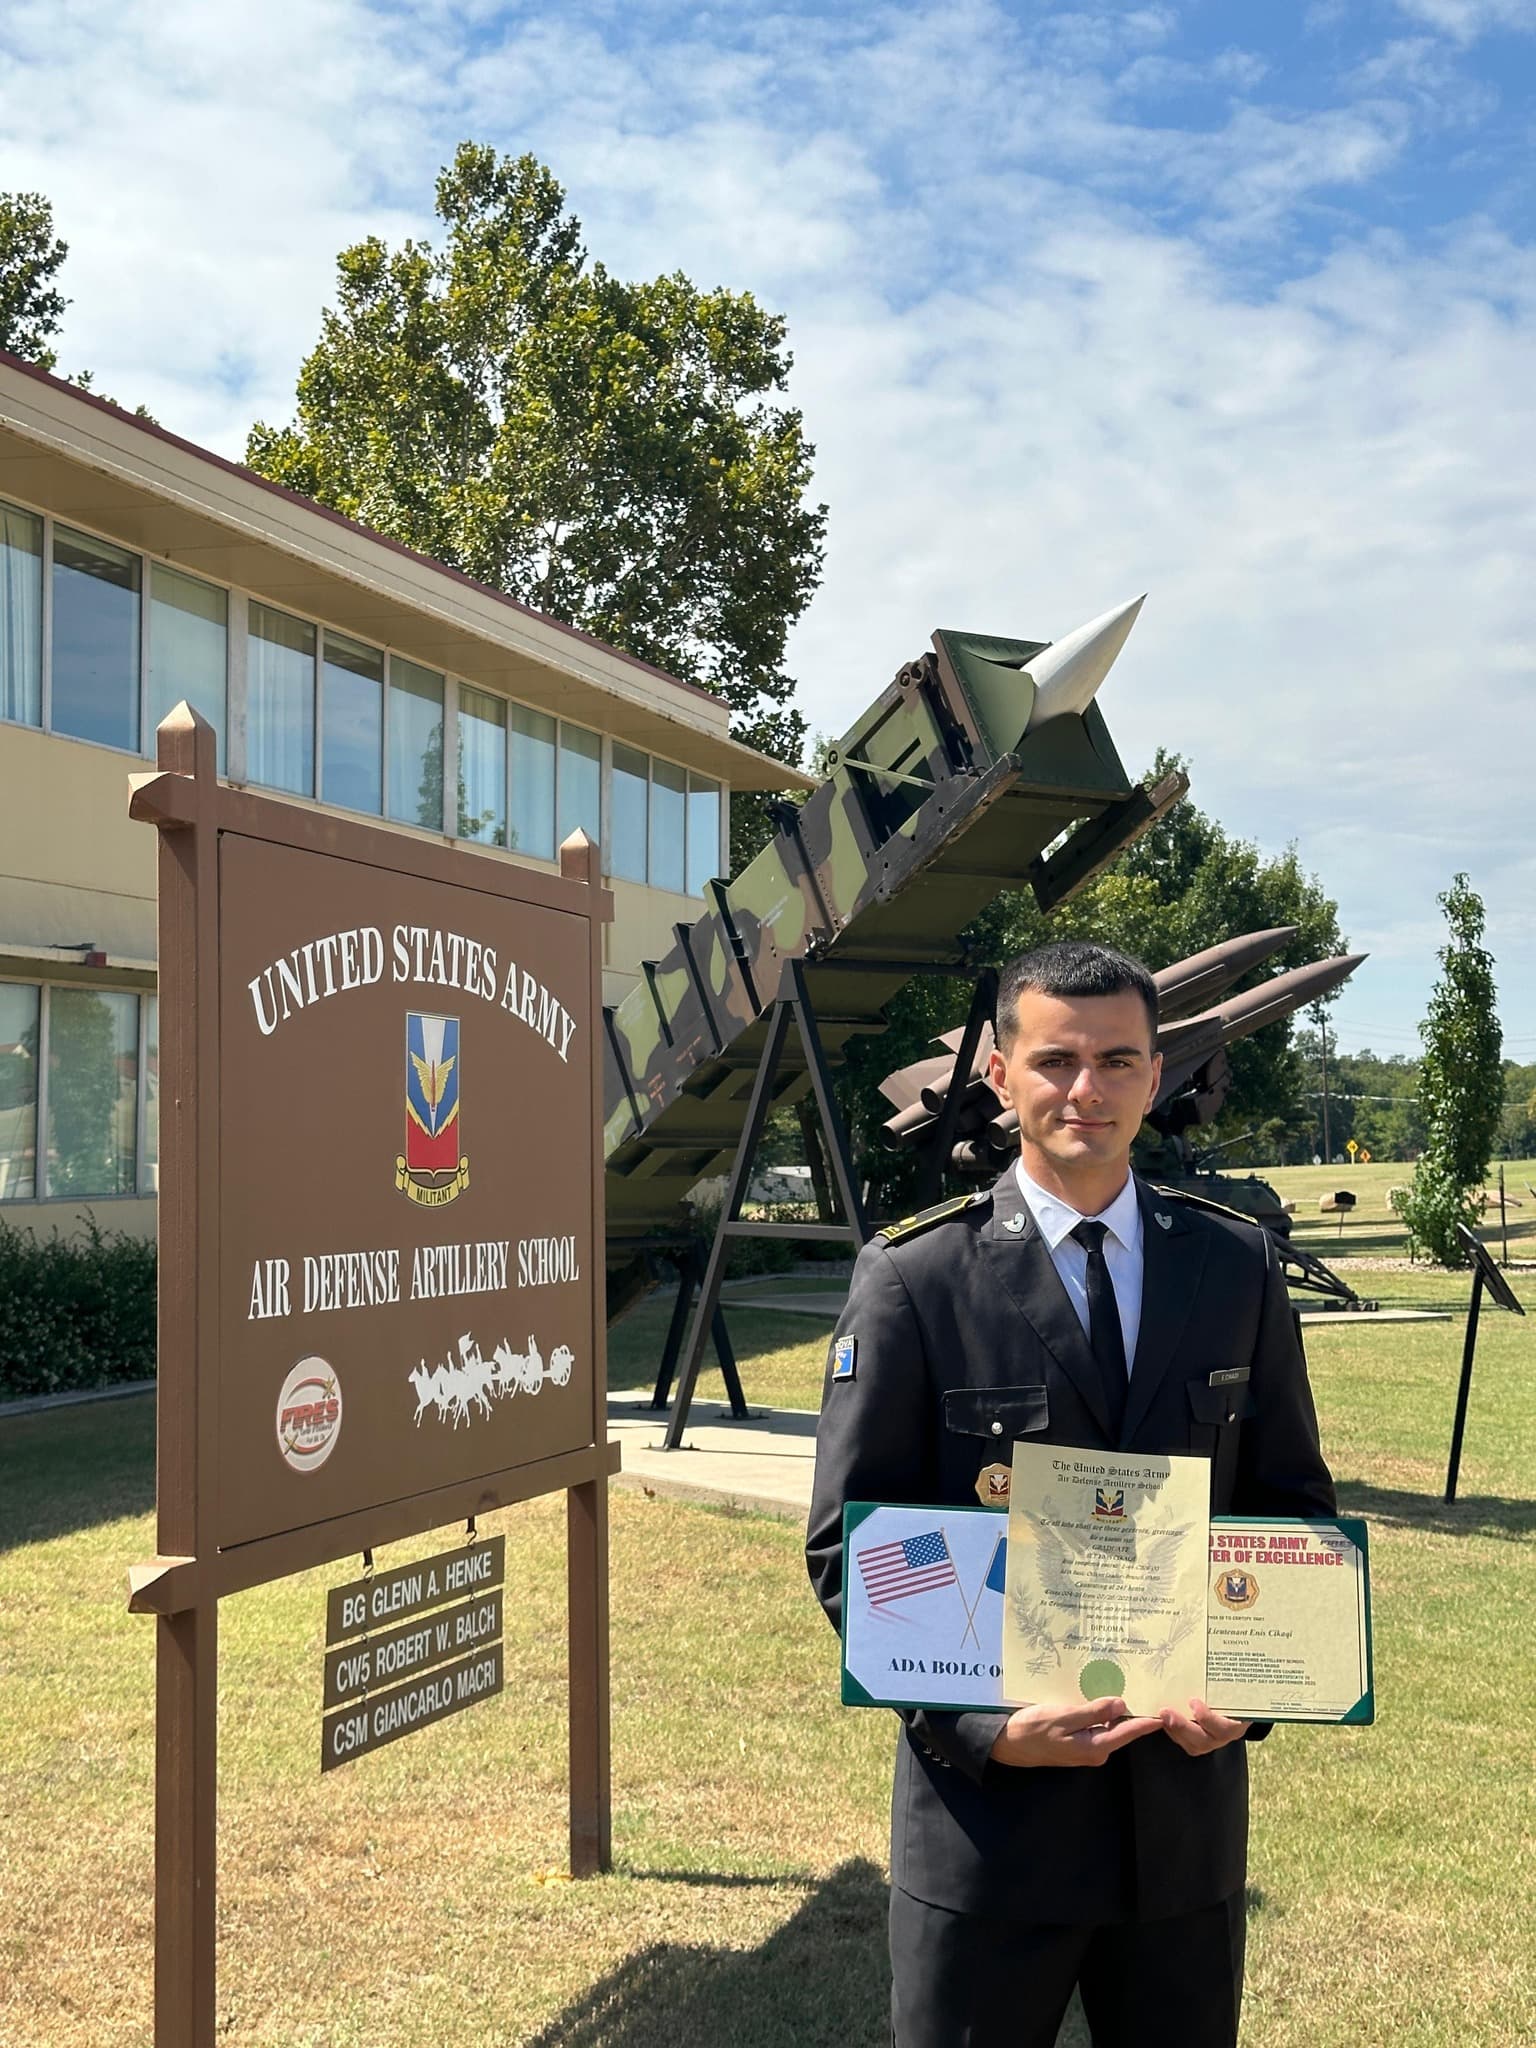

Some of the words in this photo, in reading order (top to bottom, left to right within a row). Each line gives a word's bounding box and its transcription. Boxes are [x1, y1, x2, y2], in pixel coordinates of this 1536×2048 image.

[248, 926, 384, 1036] UNITED
[392, 925, 498, 1001] STATES
[500, 961, 577, 1063] ARMY
[415, 1186, 452, 1206] MILITANT
[248, 1259, 292, 1320] AIR
[303, 1250, 400, 1313] DEFENSE
[410, 1241, 510, 1300] ARTILLERY
[518, 1236, 580, 1288] SCHOOL
[280, 1399, 339, 1435] FIRES
[1052, 1460, 1071, 1471] The
[1073, 1462, 1105, 1475] United
[1108, 1466, 1140, 1478] States
[1143, 1468, 1170, 1480] Army
[1057, 1474, 1069, 1482] Air
[1072, 1476, 1102, 1485] Defense
[1103, 1478, 1136, 1489] Artillery
[1138, 1482, 1164, 1490] School
[1217, 1535, 1266, 1548] STATES
[1268, 1536, 1309, 1550] ARMY
[1234, 1551, 1253, 1563] OF
[1255, 1551, 1344, 1566] EXCELLENCE
[342, 1594, 366, 1628] BG
[372, 1574, 422, 1618] GLENN
[427, 1571, 440, 1599] A.
[446, 1551, 492, 1591] HENKE
[1091, 1624, 1125, 1633] DIPLOMA
[1208, 1627, 1248, 1636] Lieutenant
[1249, 1628, 1266, 1637] Enis
[1268, 1629, 1293, 1639] Cikaqi
[336, 1652, 370, 1692] CW5
[376, 1629, 432, 1677] ROBERT
[436, 1622, 451, 1652] W.
[456, 1604, 496, 1645] BALCH
[888, 1658, 926, 1673] ADA
[932, 1660, 985, 1677] BOLC
[989, 1664, 1003, 1678] O
[333, 1712, 368, 1755] CSM
[374, 1677, 452, 1737] GIANCARLO
[457, 1658, 496, 1700] MACRI
